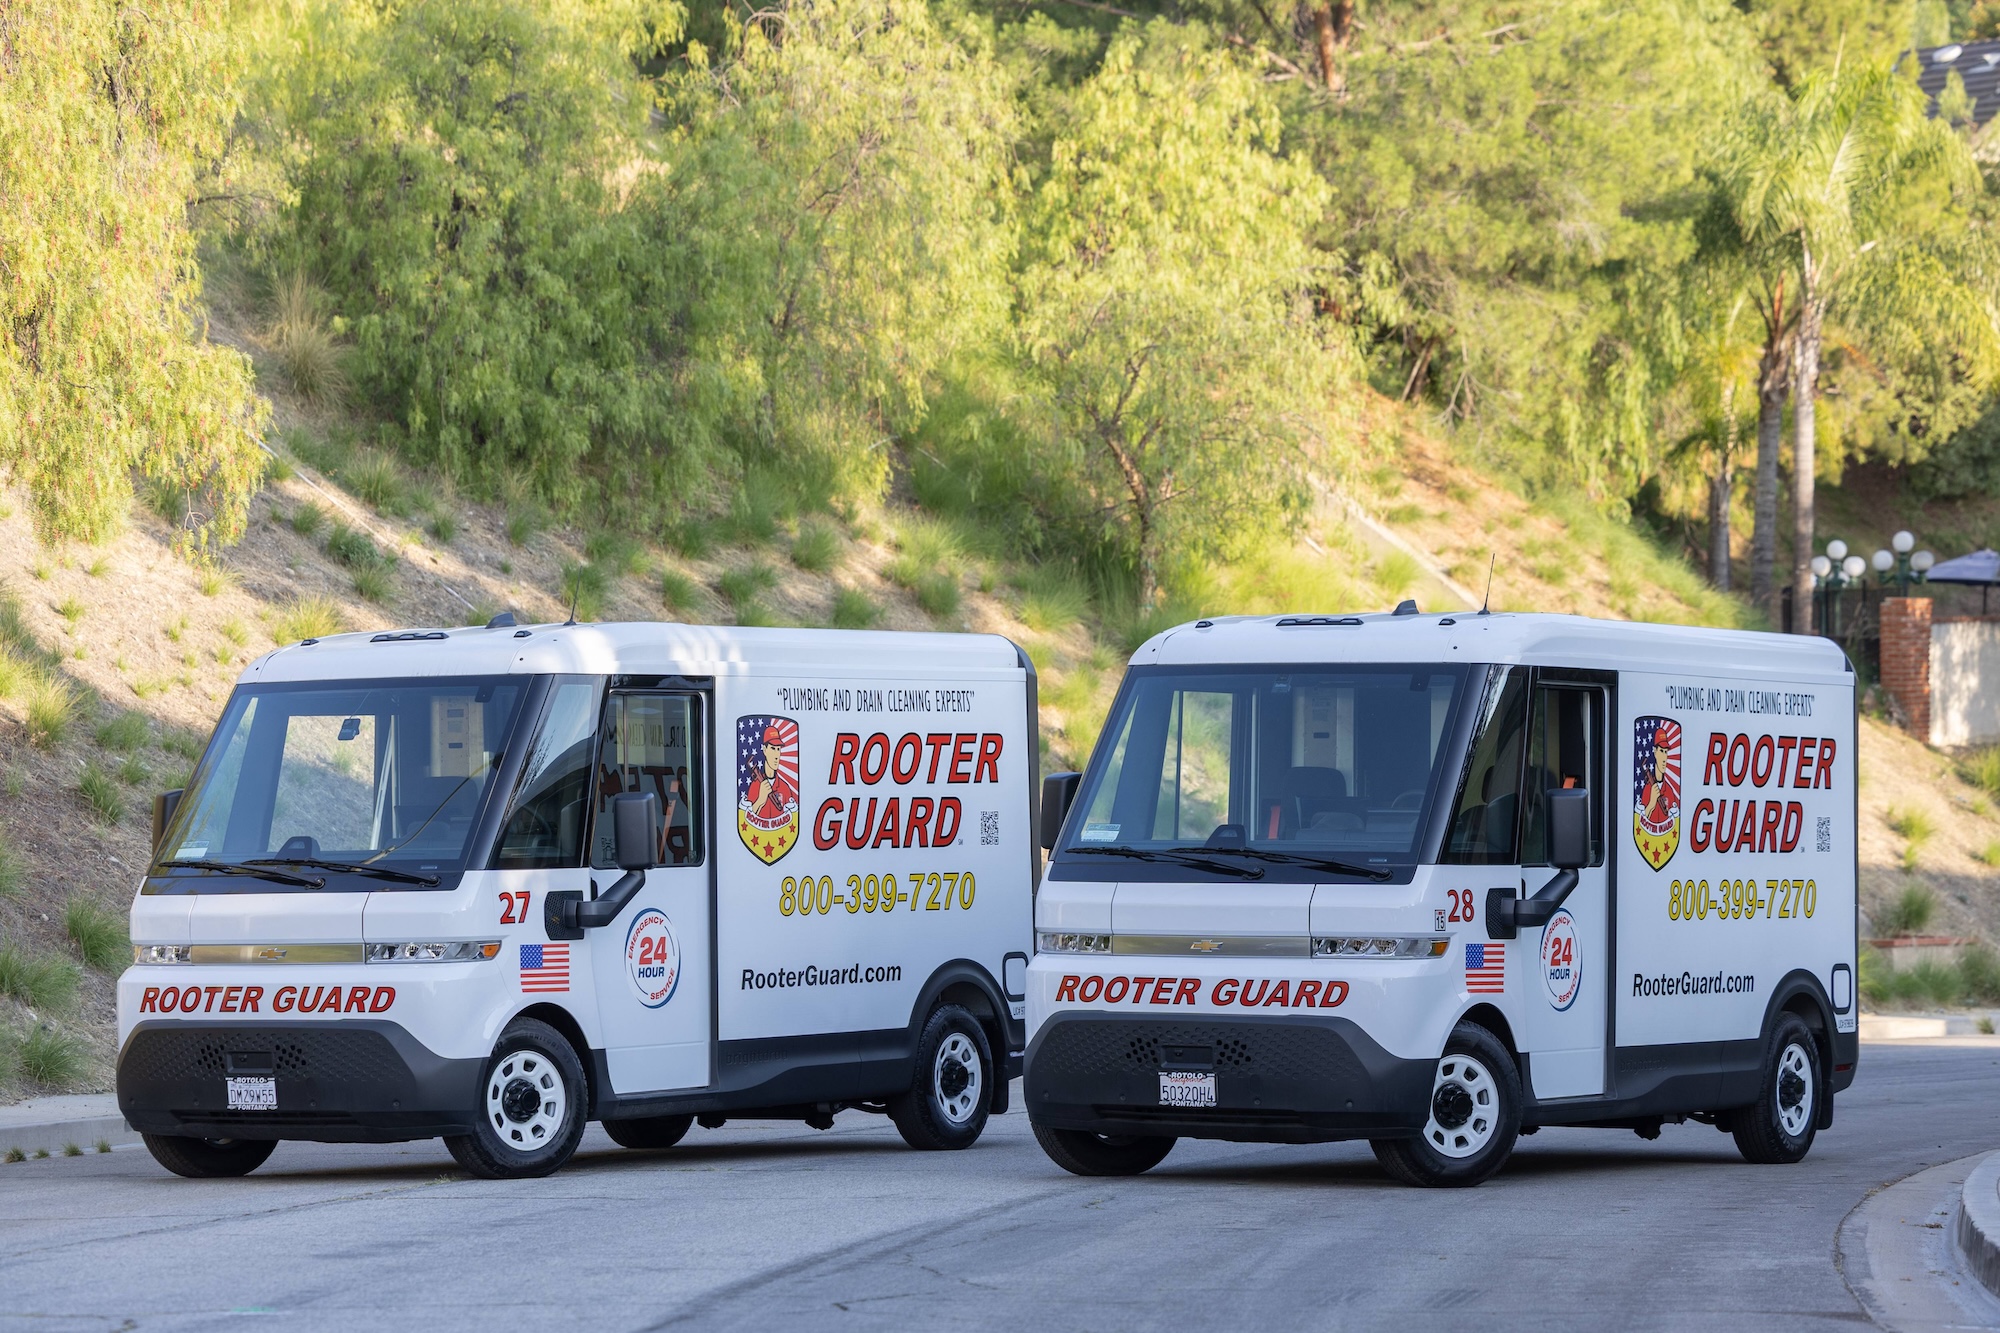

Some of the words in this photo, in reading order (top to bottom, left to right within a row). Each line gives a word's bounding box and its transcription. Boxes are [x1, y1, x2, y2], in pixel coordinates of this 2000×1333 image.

[833, 689, 851, 712] AND
[857, 690, 883, 712] DRAIN
[888, 690, 931, 712] CLEANING
[1707, 688, 1721, 712] AND
[1725, 689, 1745, 713] DRAIN
[1748, 691, 1781, 715] CLEANING
[828, 732, 1004, 785] ROOTER
[1703, 732, 1836, 790] ROOTER
[813, 797, 962, 851] GUARD
[1690, 798, 1803, 853] GUARD
[498, 891, 531, 924] 27
[779, 871, 976, 917] 800-399-7270
[1447, 889, 1475, 922] 28
[1668, 879, 1817, 921] 800-399-7270
[628, 916, 664, 959] EMERGENCY
[1436, 915, 1445, 929] 15
[639, 936, 667, 965] 24
[1543, 917, 1570, 960] EMERGENCY
[1550, 937, 1572, 966] 24
[638, 966, 665, 978] HOUR
[650, 968, 675, 1000] SERVICE
[741, 963, 902, 990] RooterGuard.com
[1550, 968, 1570, 979] HOUR
[1558, 970, 1578, 1002] SERVICE
[1633, 971, 1754, 997] RooterGuard.com
[139, 986, 264, 1013] ROOTER
[272, 986, 396, 1013] GUARD
[1056, 975, 1201, 1006] ROOTER
[1211, 978, 1350, 1008] GUARD
[1162, 1085, 1214, 1101] 50320H4
